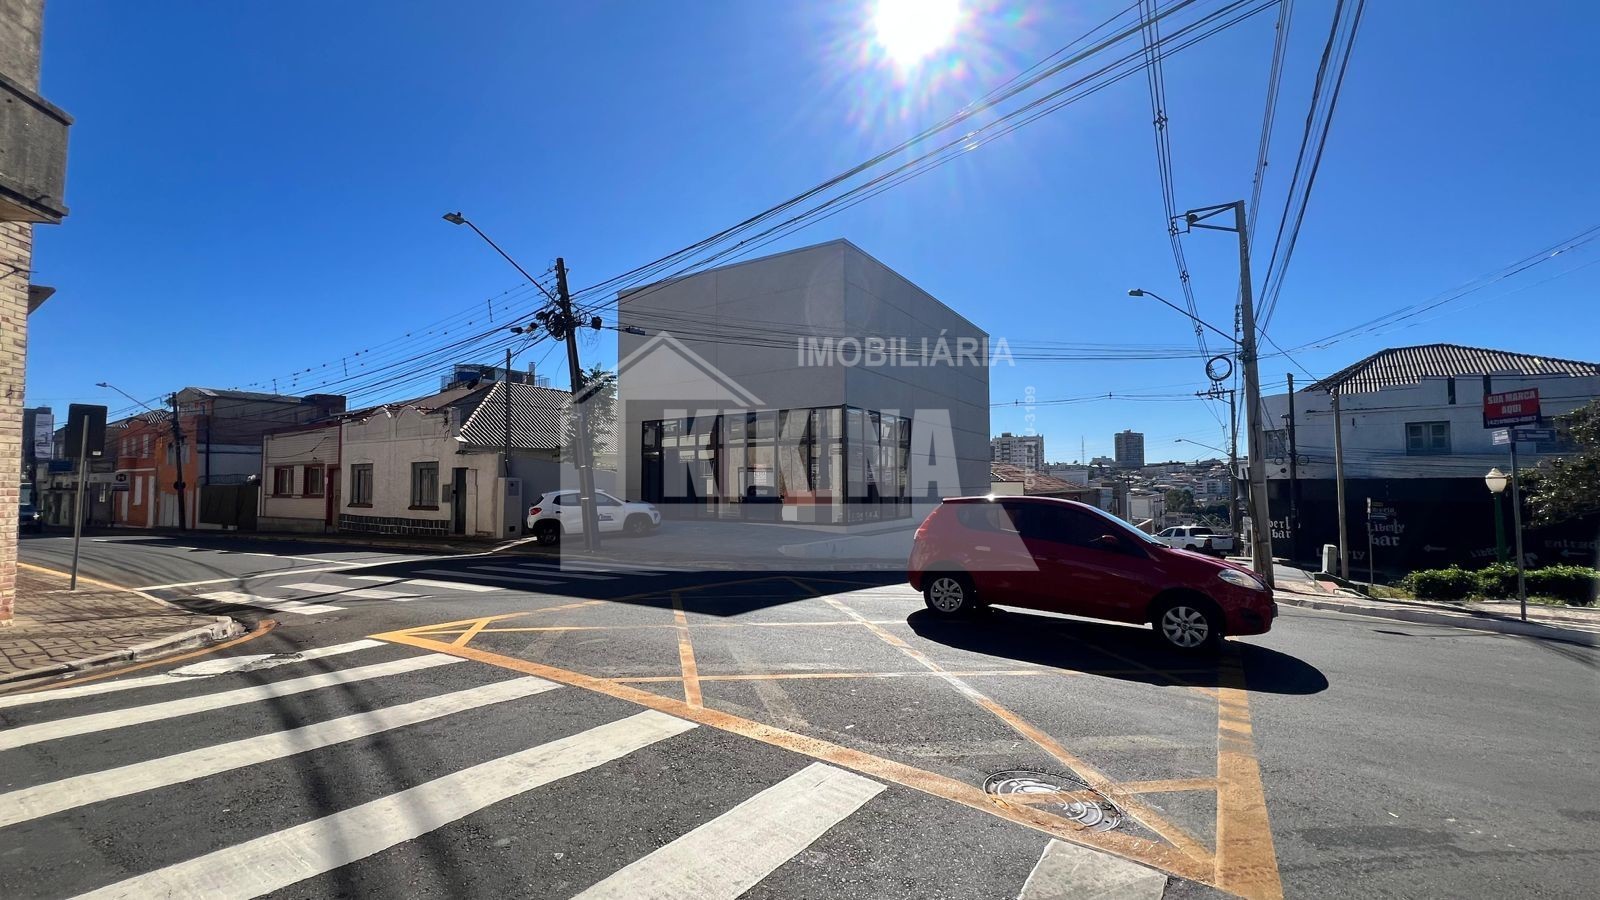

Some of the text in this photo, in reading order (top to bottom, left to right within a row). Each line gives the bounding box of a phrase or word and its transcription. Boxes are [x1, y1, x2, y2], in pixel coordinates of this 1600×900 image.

[1487, 390, 1536, 405] SUA MARCA
[1501, 404, 1522, 414] AQUI
[1271, 528, 1292, 539] bar
[1370, 534, 1400, 547] bar
